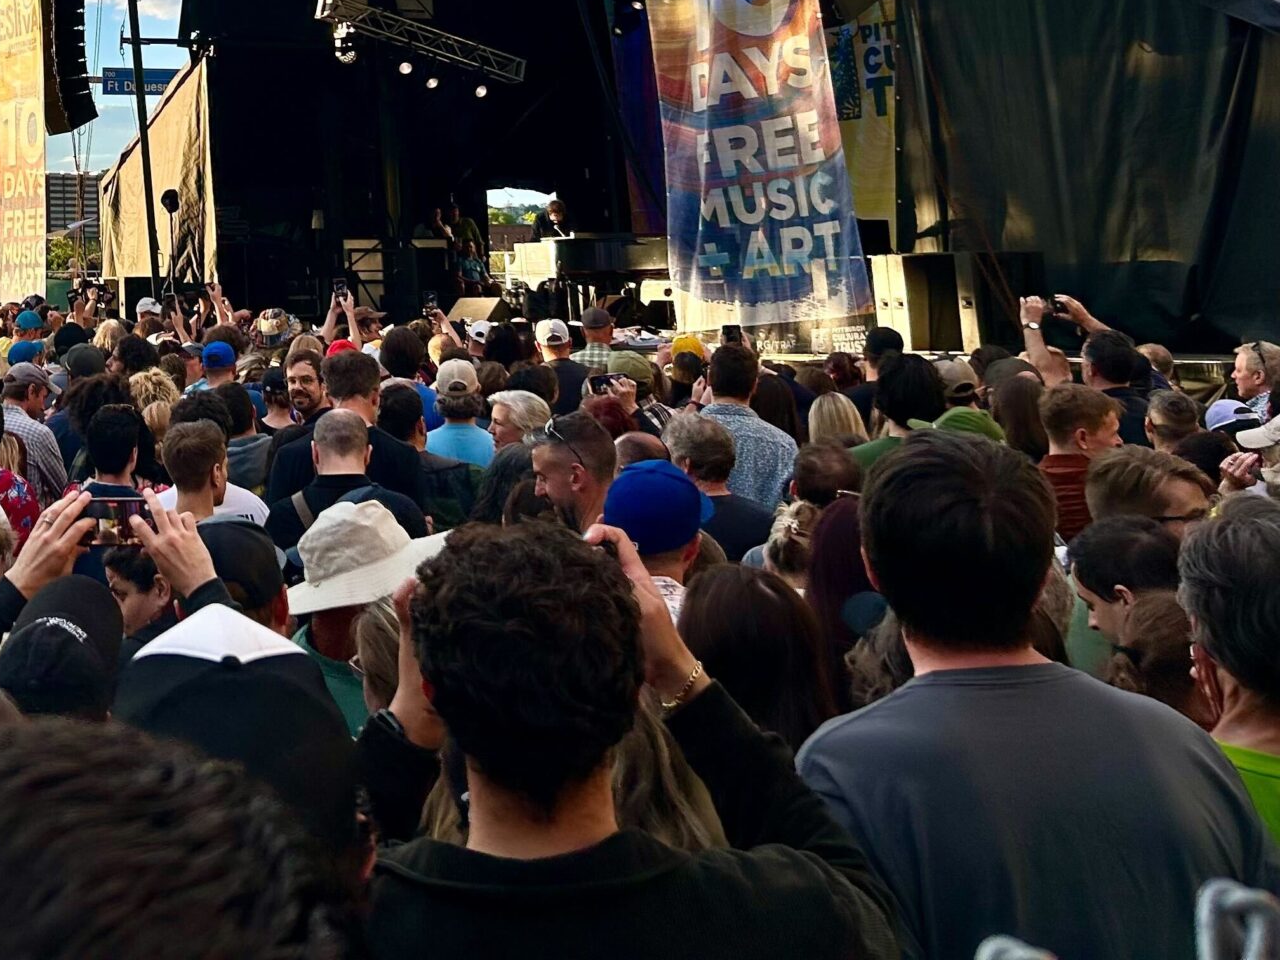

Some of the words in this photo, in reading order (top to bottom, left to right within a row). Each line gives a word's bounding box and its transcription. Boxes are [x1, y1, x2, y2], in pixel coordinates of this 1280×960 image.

[107, 80, 119, 92] Ft
[690, 34, 813, 113] DAYS
[1, 102, 44, 167] 10
[696, 109, 826, 182] FREE
[3, 207, 45, 239] FREE
[700, 170, 837, 229] MUSIC
[1, 242, 45, 266] MUSIC
[741, 220, 841, 280] ART
[12, 267, 45, 294] ART
